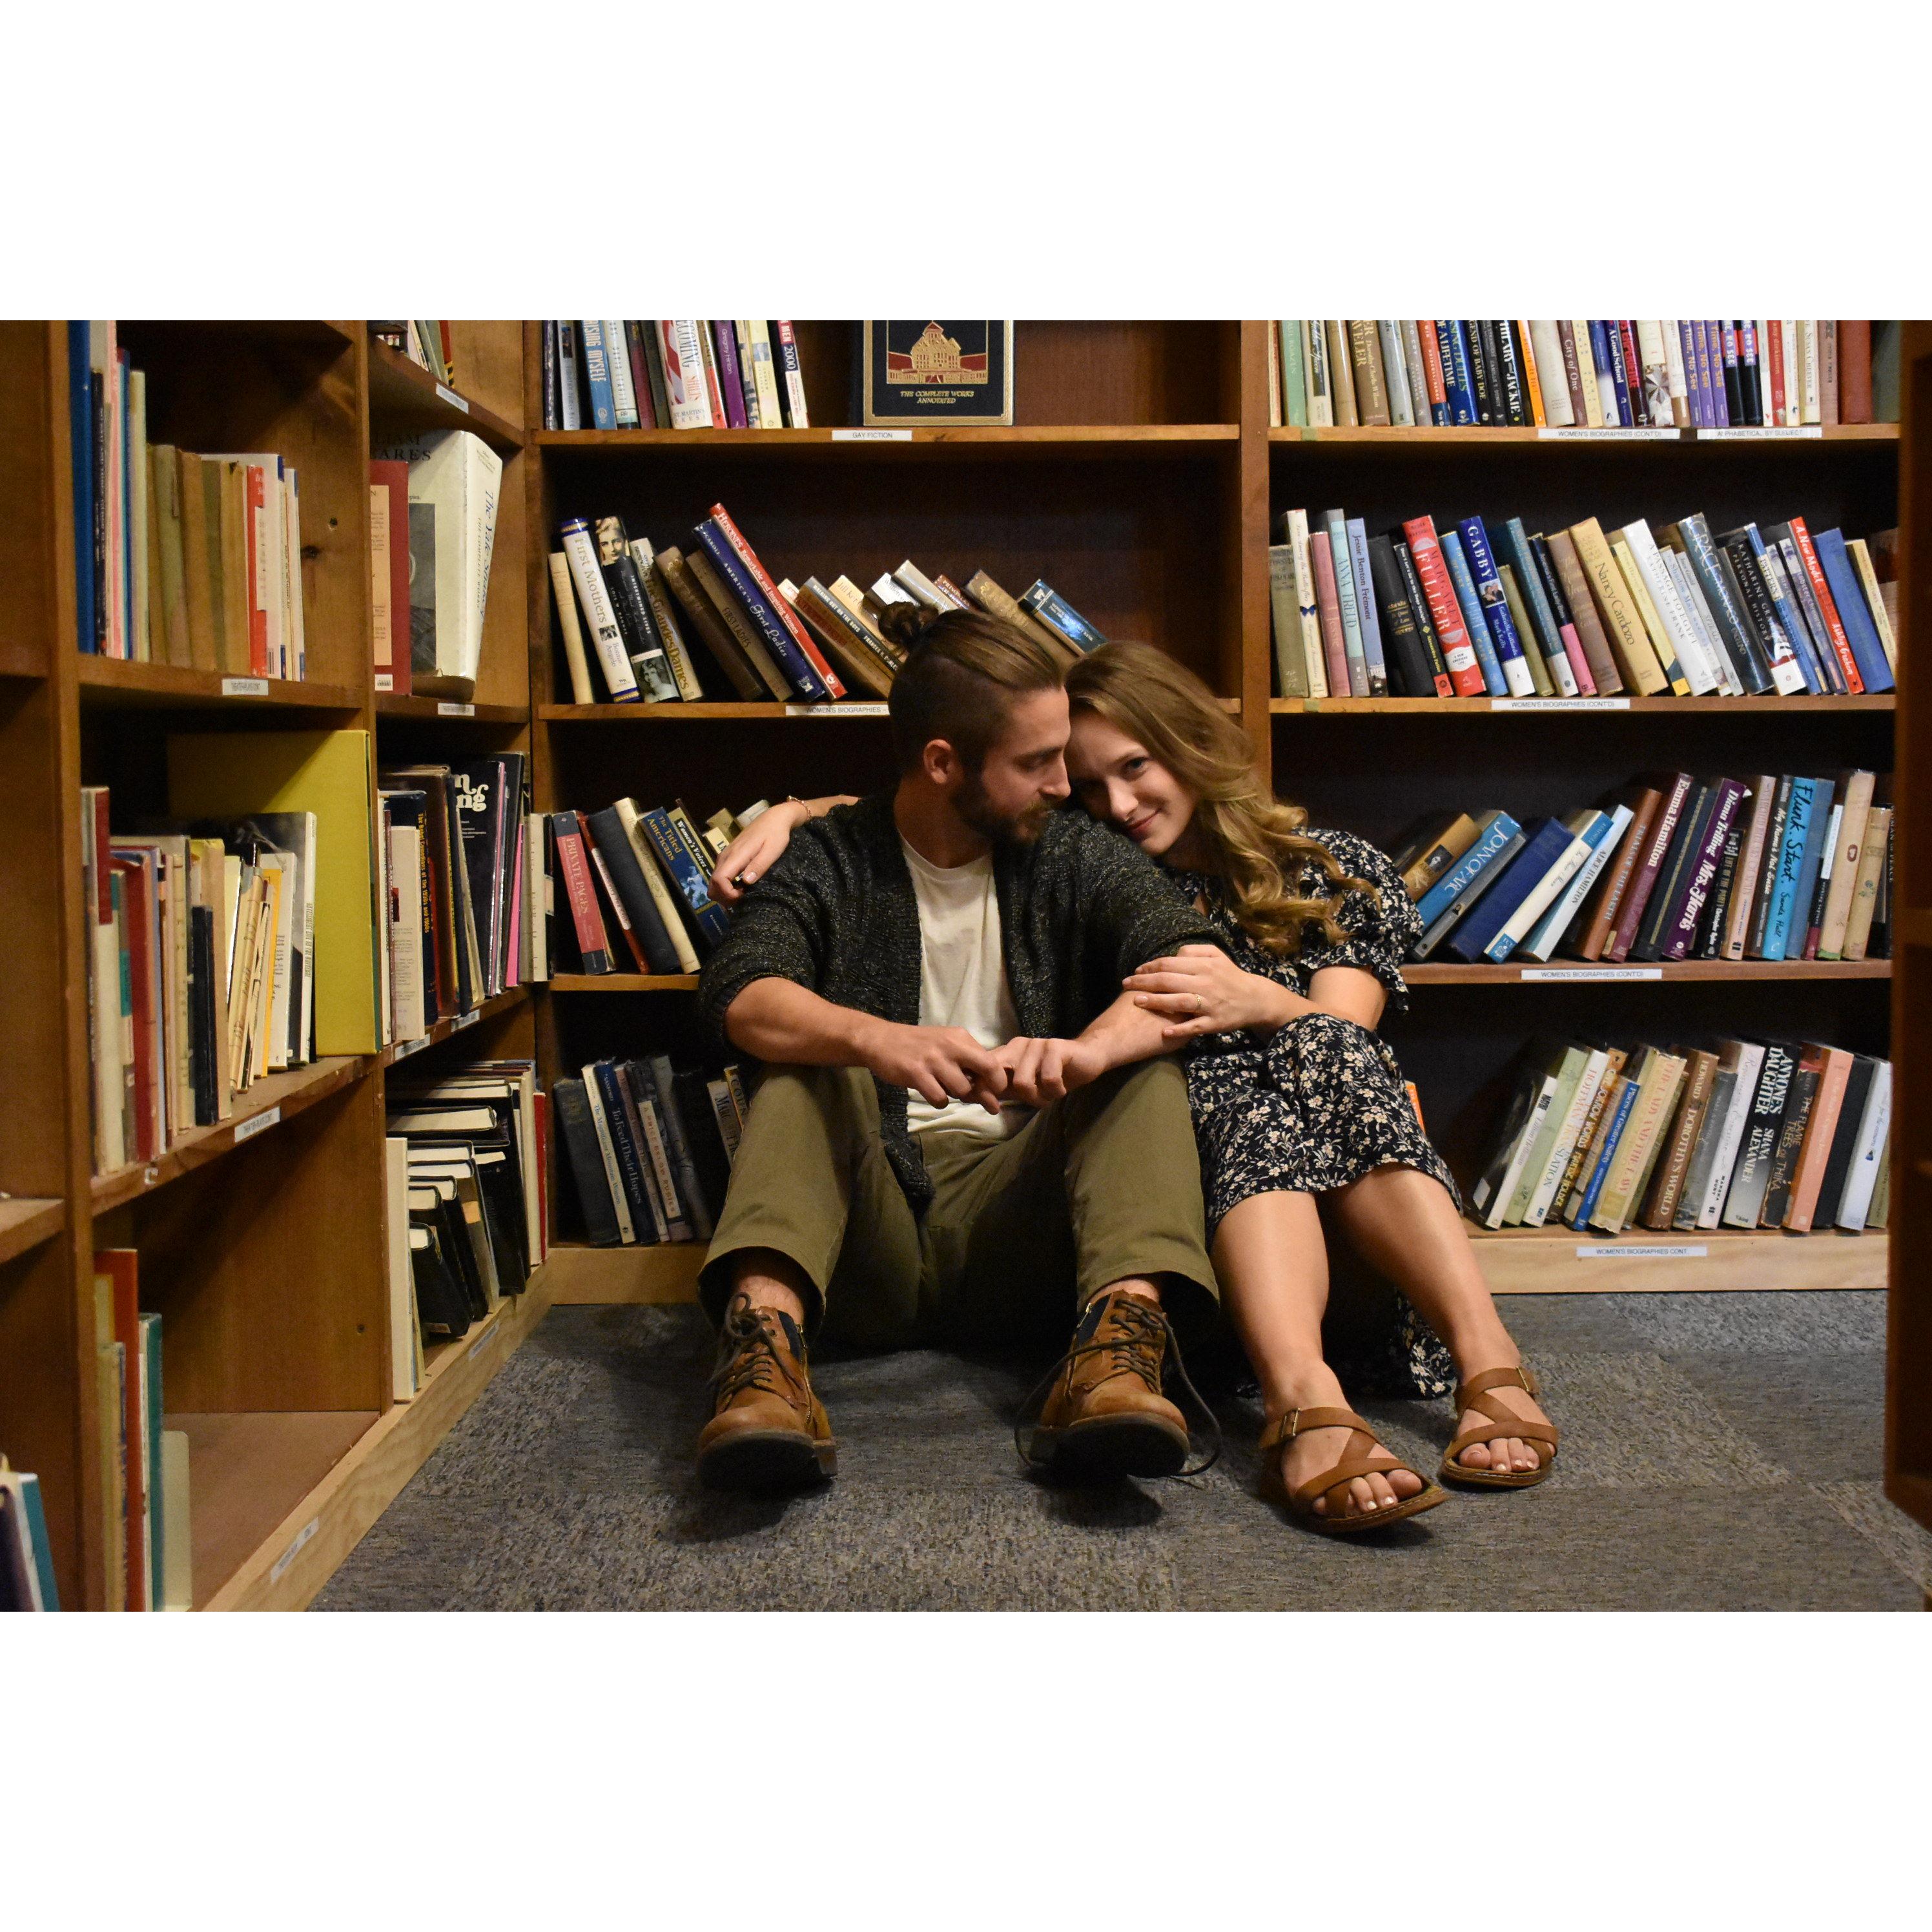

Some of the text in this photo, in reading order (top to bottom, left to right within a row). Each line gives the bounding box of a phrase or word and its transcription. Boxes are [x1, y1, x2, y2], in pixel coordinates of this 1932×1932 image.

[719, 328, 730, 353] Gregory
[780, 325, 792, 342] MEN
[783, 345, 797, 370] 2000
[1610, 334, 1619, 356] Good
[587, 349, 606, 382] MYSELF
[1440, 340, 1455, 387] LIFETIME
[1472, 344, 1486, 400] OF BABY DOE
[1563, 339, 1579, 389] City of One
[1613, 357, 1624, 382] School
[1687, 356, 1695, 369] No
[1700, 354, 1707, 366] No
[1713, 353, 1720, 366] No
[1505, 371, 1520, 413] JACKIE
[483, 491, 495, 518] The
[1466, 524, 1492, 579] GABBY
[1685, 518, 1723, 576] GRACE
[1737, 543, 1763, 599] KATHARINE
[573, 536, 610, 623] First Mothers
[644, 575, 661, 598] The
[717, 512, 799, 634] HEROINES Remarkable and Inspiring Women
[836, 581, 850, 595] Jill
[1337, 556, 1357, 628] ANNA FREUD
[1353, 533, 1373, 620] Jessie Benton Frémont
[1415, 551, 1451, 631] FULLER
[1429, 549, 1460, 627] MARGARET
[1648, 542, 1698, 645] A PASSAGE TO EGYPT
[1731, 553, 1770, 642] PERSONAL HISTORY
[1759, 558, 1780, 595] PATTERN
[628, 575, 646, 615] INTERTWINED
[642, 617, 651, 634] LIVES
[650, 597, 678, 649] Grandes
[722, 561, 791, 657] AMERICA'S First Ladies
[1416, 605, 1426, 624] Tonight
[1595, 561, 1639, 646] Nancy Cardozo
[1794, 524, 1856, 675] A New Model Ashley Graham
[720, 606, 751, 648] FIRST LADIES
[1326, 616, 1342, 646] Jessie
[1492, 617, 1506, 648] Mark Kelly
[1498, 605, 1518, 655] Gabrielle Giffords
[1668, 610, 1686, 640] FRANK
[668, 646, 692, 689] Dames
[1433, 657, 1442, 673] Fuller
[644, 817, 677, 861] Americans
[656, 815, 684, 854] The Titled
[675, 819, 708, 868] Women's Voices
[1647, 777, 1690, 868] Emma Hamilton
[1768, 808, 1786, 870] My Name's Not
[566, 837, 582, 880] PRIVATE
[575, 881, 590, 914] PAGES
[1443, 821, 1512, 898] JOAN OF ARC
[1591, 848, 1607, 870] ALICE
[1616, 868, 1629, 888] THE
[1678, 788, 1739, 931] Diana Trilling Mrs. Harris
[1773, 783, 1814, 937] Flunk. Start. Sands Hall
[1570, 868, 1596, 905] HAMILTON
[1569, 1067, 1598, 1121] HOFFMAN
[1622, 1087, 1636, 1111] Places
[1754, 1045, 1783, 1115] DAUGHTER
[1768, 1054, 1794, 1115] ANYONE'S
[1609, 1117, 1625, 1144] Greater
[1659, 1059, 1709, 1215] HOWARD DOROTHY'S WORLD
[1758, 1127, 1774, 1160] SHANA
[1791, 1094, 1812, 1146] THE FLAME
[610, 1107, 644, 1204] To Feed Their Hopes
[1516, 1138, 1534, 1167] Hellman
[1554, 1086, 1608, 1208] SORROW WORDS HOLDER
[1601, 1143, 1614, 1165] Safety
[1741, 1125, 1763, 1182] ALEXANDER
[1770, 1118, 1796, 1192] TREES THIKA
[611, 1182, 622, 1204] Women
